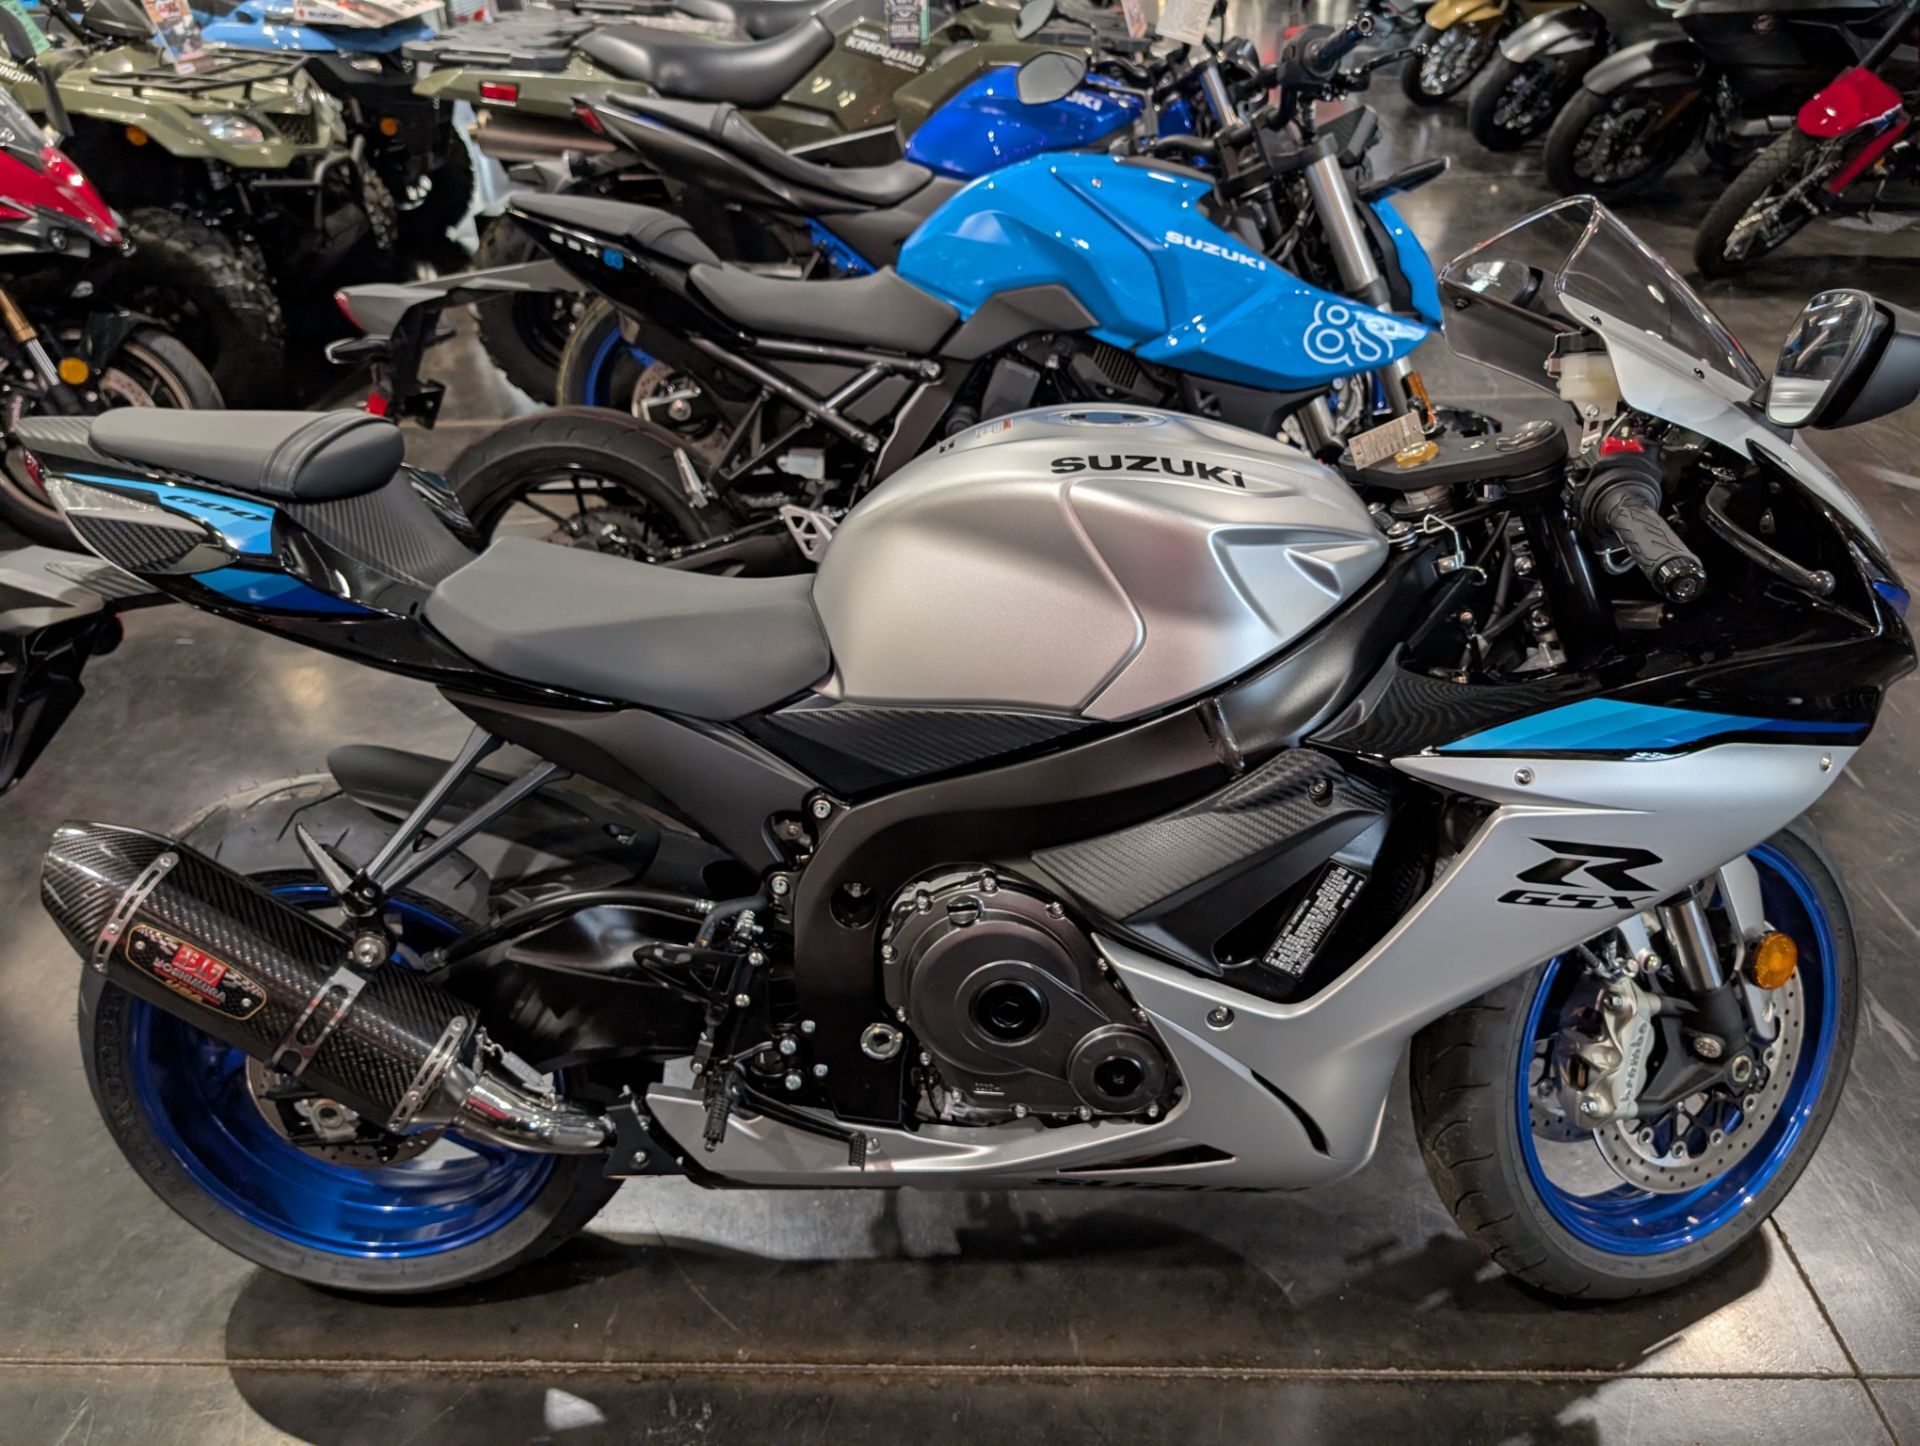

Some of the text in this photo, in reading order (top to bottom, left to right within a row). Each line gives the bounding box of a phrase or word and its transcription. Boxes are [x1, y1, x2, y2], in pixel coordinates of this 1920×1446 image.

[844, 35, 927, 68] KINGQUAD
[1164, 230, 1266, 272] SUZUKI
[1050, 454, 1246, 489] SUZUKI
[1496, 889, 1657, 910] GSX
[152, 957, 227, 1001] YOSHIMURA
[1620, 1022, 1648, 1101] brembo
